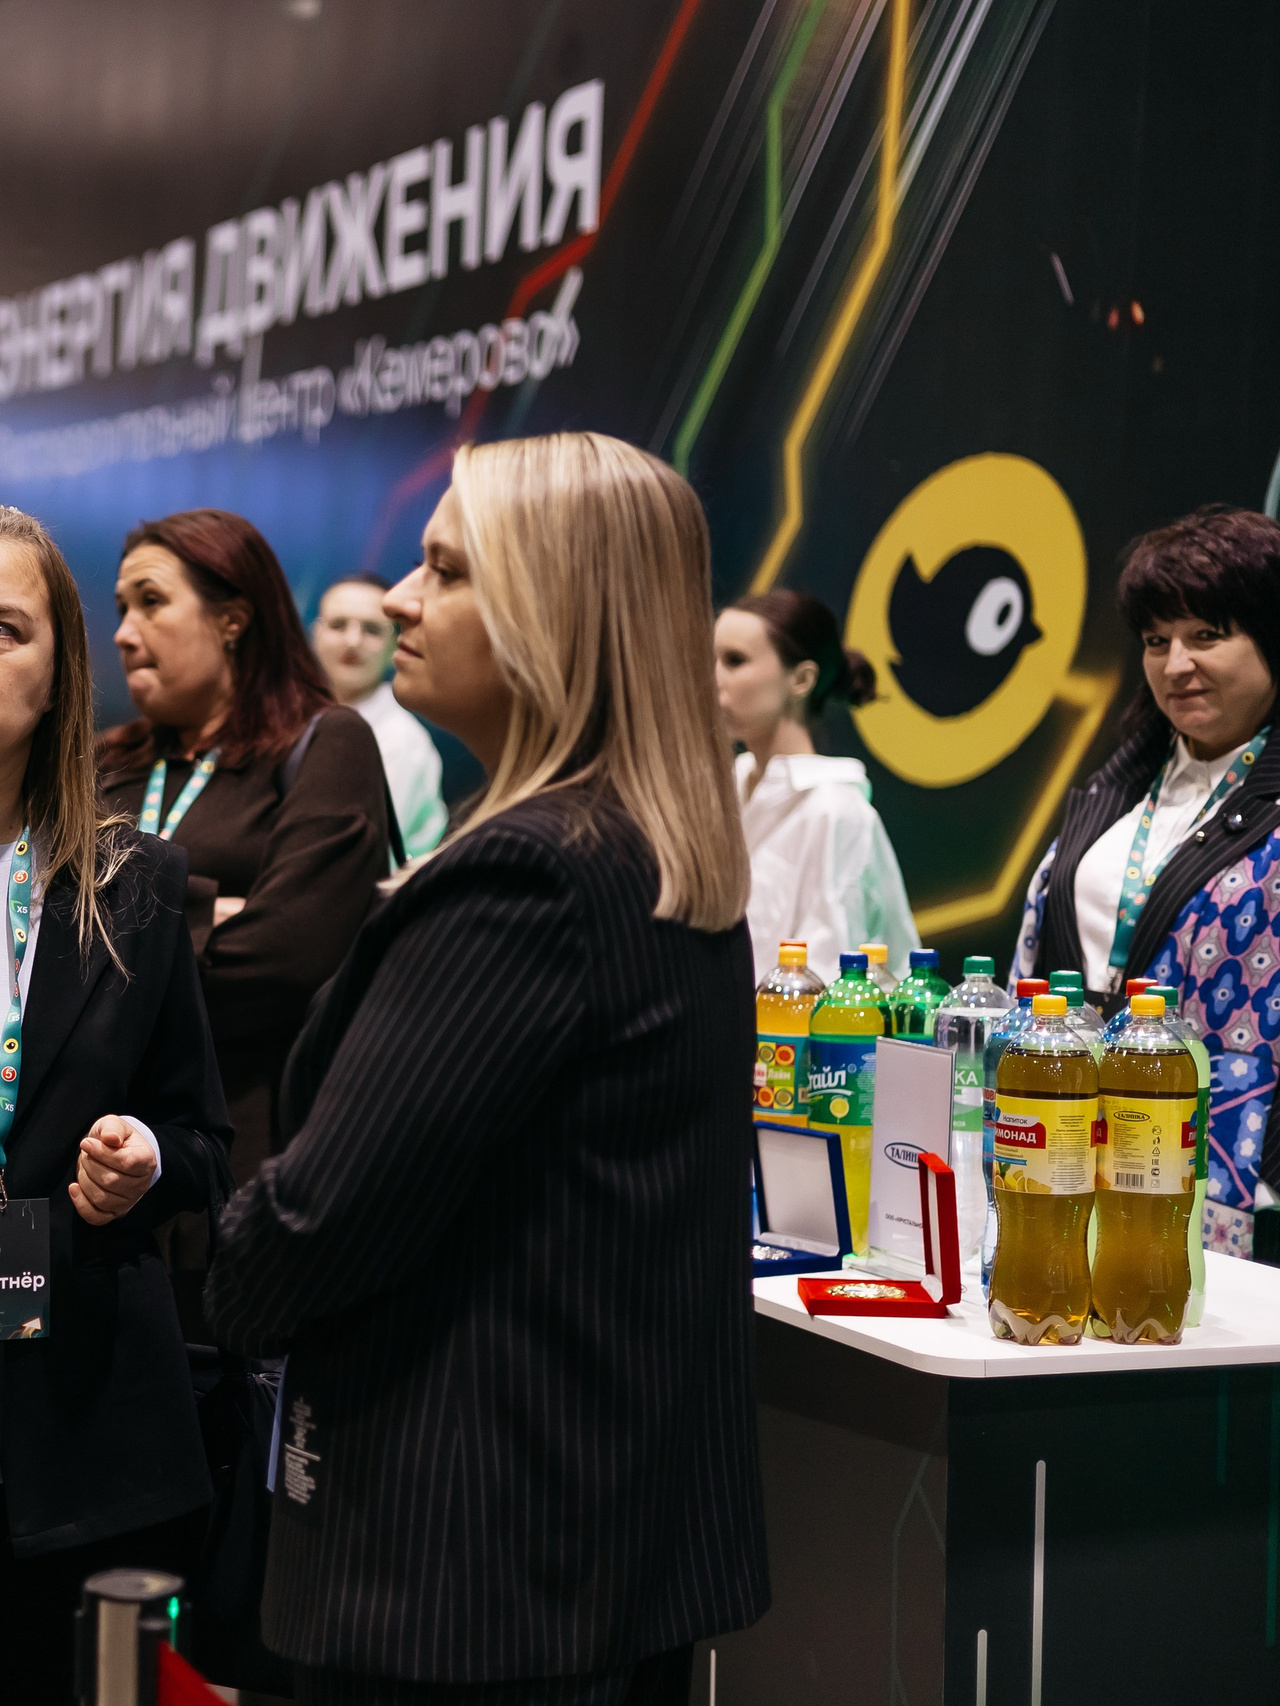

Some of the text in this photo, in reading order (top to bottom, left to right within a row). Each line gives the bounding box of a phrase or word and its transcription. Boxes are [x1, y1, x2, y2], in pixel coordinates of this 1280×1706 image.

[195, 78, 604, 366] ДВИЖЕНИЯ
[16, 905, 28, 914] X5
[4, 1103, 14, 1112] X5
[1003, 1115, 1028, 1124] Напиток
